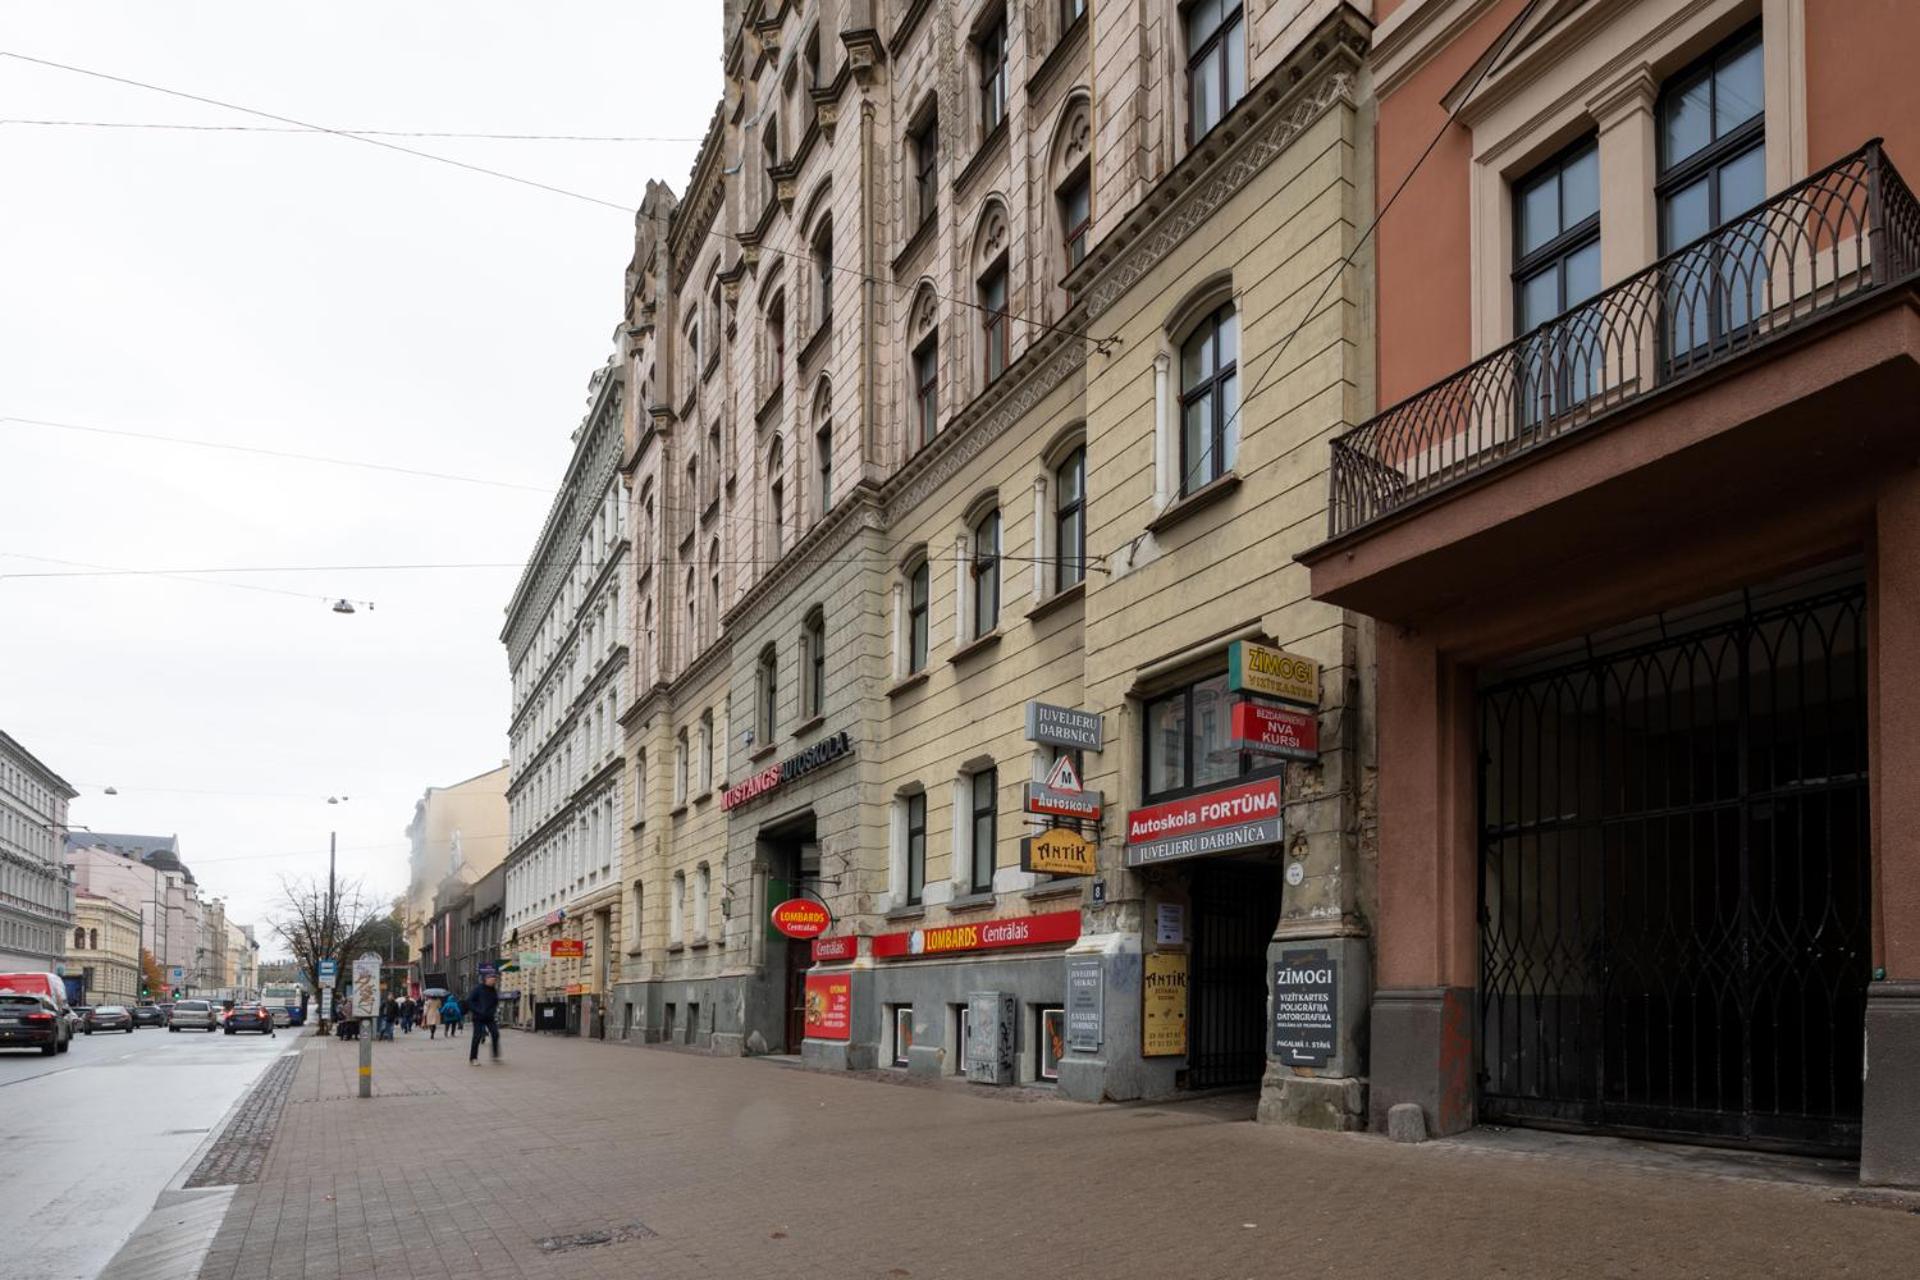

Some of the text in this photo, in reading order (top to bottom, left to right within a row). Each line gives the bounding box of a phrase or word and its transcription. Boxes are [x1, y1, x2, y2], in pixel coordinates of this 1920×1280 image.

[1248, 647, 1313, 684] ZĪMOGI
[1039, 708, 1098, 730] JUVELIERU
[1267, 721, 1294, 736] NVA
[1039, 723, 1096, 744] DARBNĪCA
[1262, 732, 1300, 748] KURSI
[1061, 771, 1072, 784] M
[1038, 792, 1092, 813] Autoskola
[1131, 791, 1278, 836] Autoskola FORTŪNA
[1140, 825, 1265, 863] JUVELIERU DARBNĪCA
[1095, 886, 1100, 898] 8
[780, 912, 825, 923] LOMBARDS
[926, 921, 1029, 950] LOMBARDS Centrālais
[1277, 968, 1332, 984] ZĪMOGI
